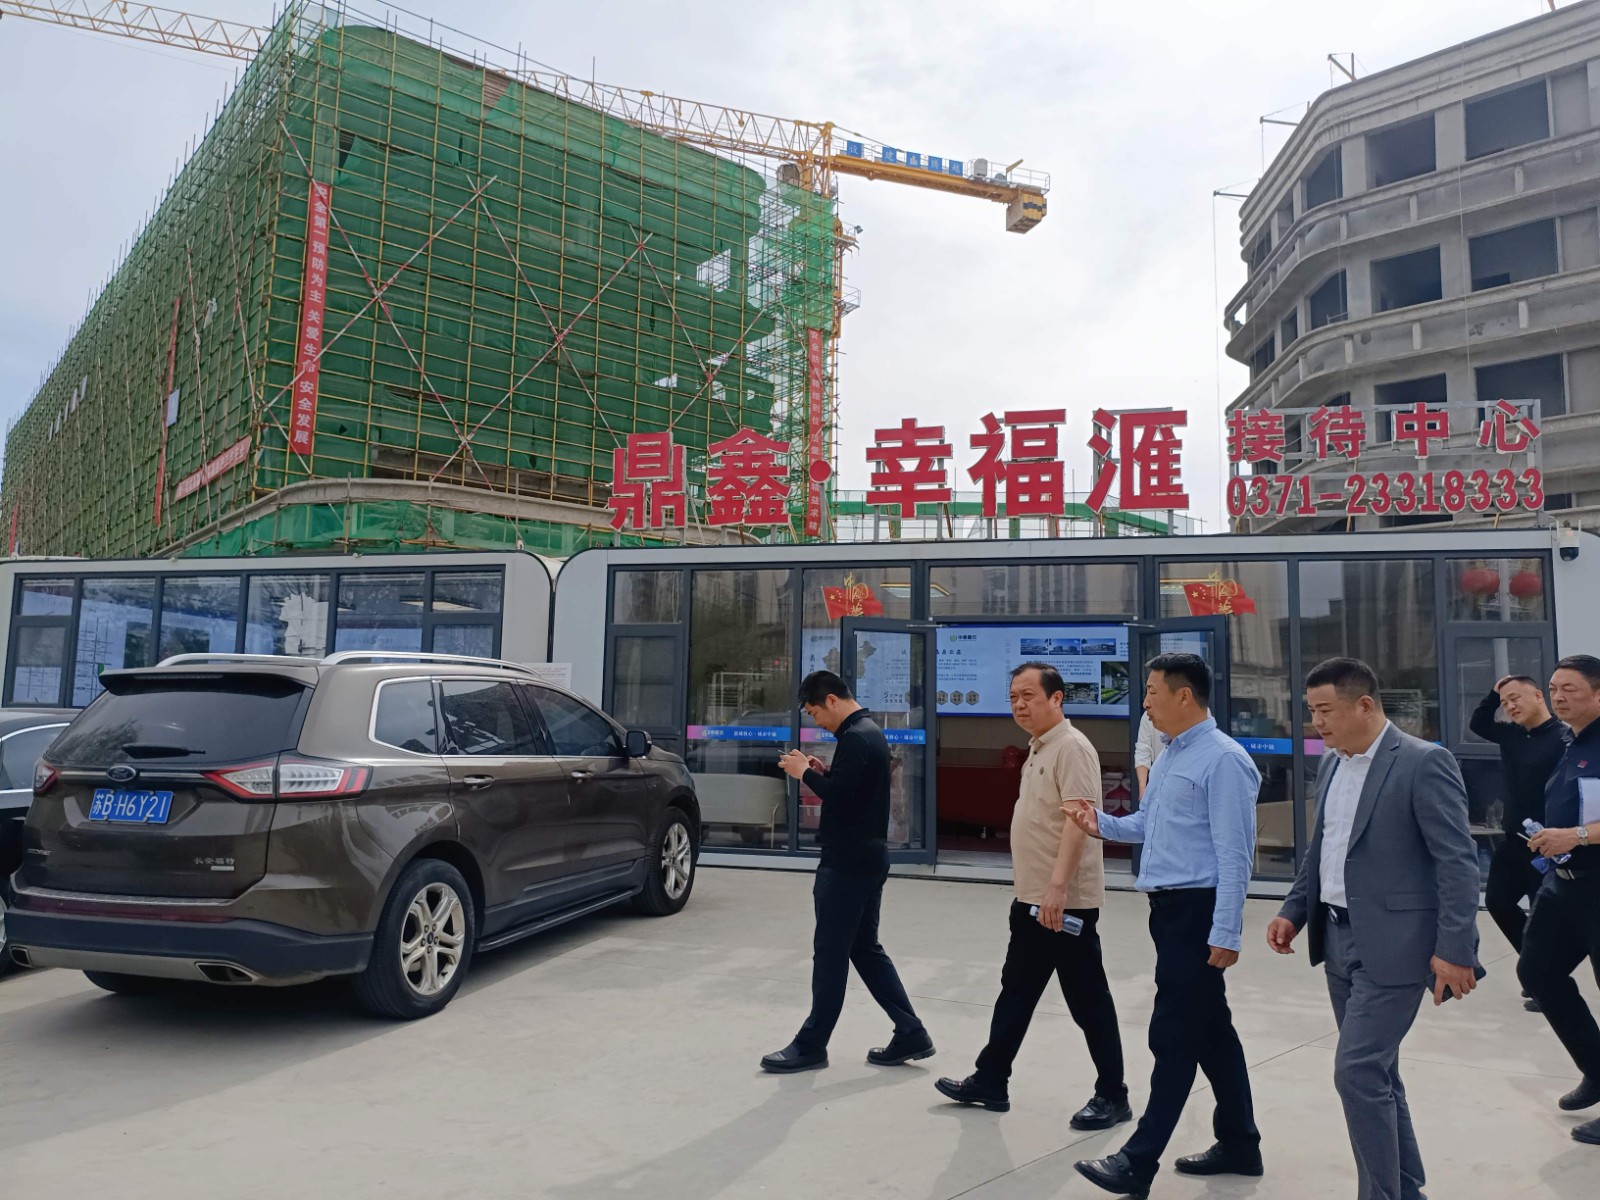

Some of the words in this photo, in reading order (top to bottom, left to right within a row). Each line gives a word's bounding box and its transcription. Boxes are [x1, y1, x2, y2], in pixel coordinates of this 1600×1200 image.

[1226, 399, 1542, 464] 接待中心
[1226, 468, 1545, 518] 0371-23318333
